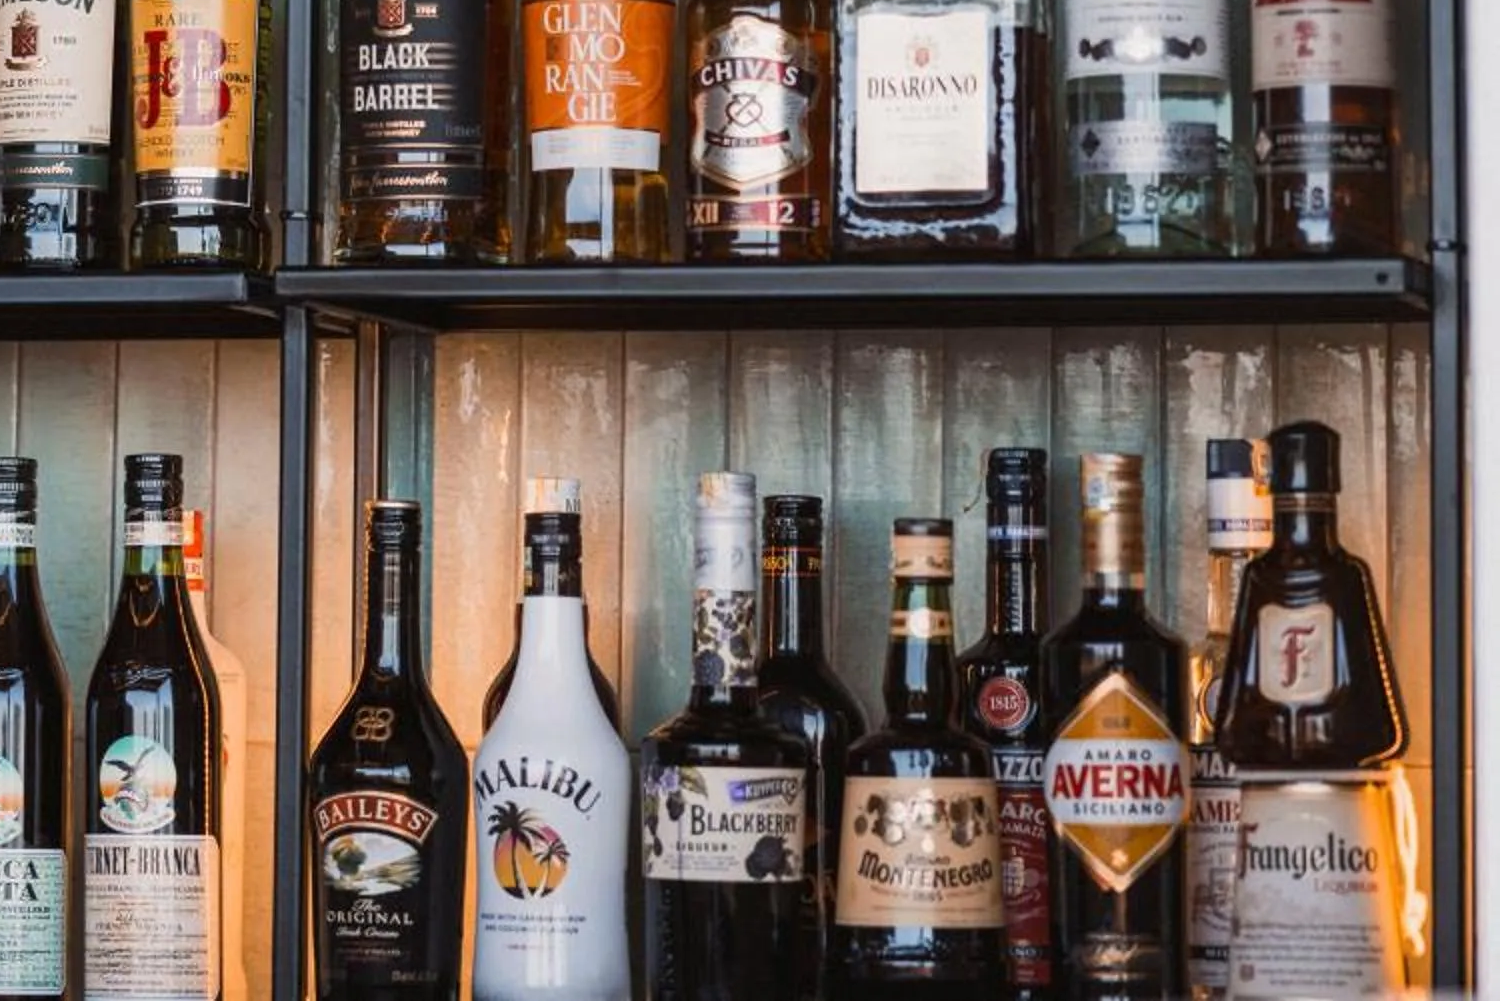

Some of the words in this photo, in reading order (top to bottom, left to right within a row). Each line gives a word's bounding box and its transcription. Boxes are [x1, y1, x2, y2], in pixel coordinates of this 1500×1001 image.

[543, 3, 622, 33] GLEN
[359, 43, 430, 70] BLACK
[569, 33, 625, 63] MO
[545, 63, 605, 94] RAN
[700, 60, 800, 88] CHIVAS
[867, 74, 978, 100] DISARONNO
[354, 83, 440, 112] BARREL
[567, 92, 617, 122] GIE
[1084, 749, 1153, 761] AMARO
[1052, 763, 1185, 799] AVERNA
[318, 800, 430, 832] BAILEYS
[1073, 802, 1166, 817] SICILIANO
[1239, 822, 1379, 880] Frangelico
[857, 850, 993, 888] MONTENEGRO
[325, 910, 414, 926] ORIGINAL
